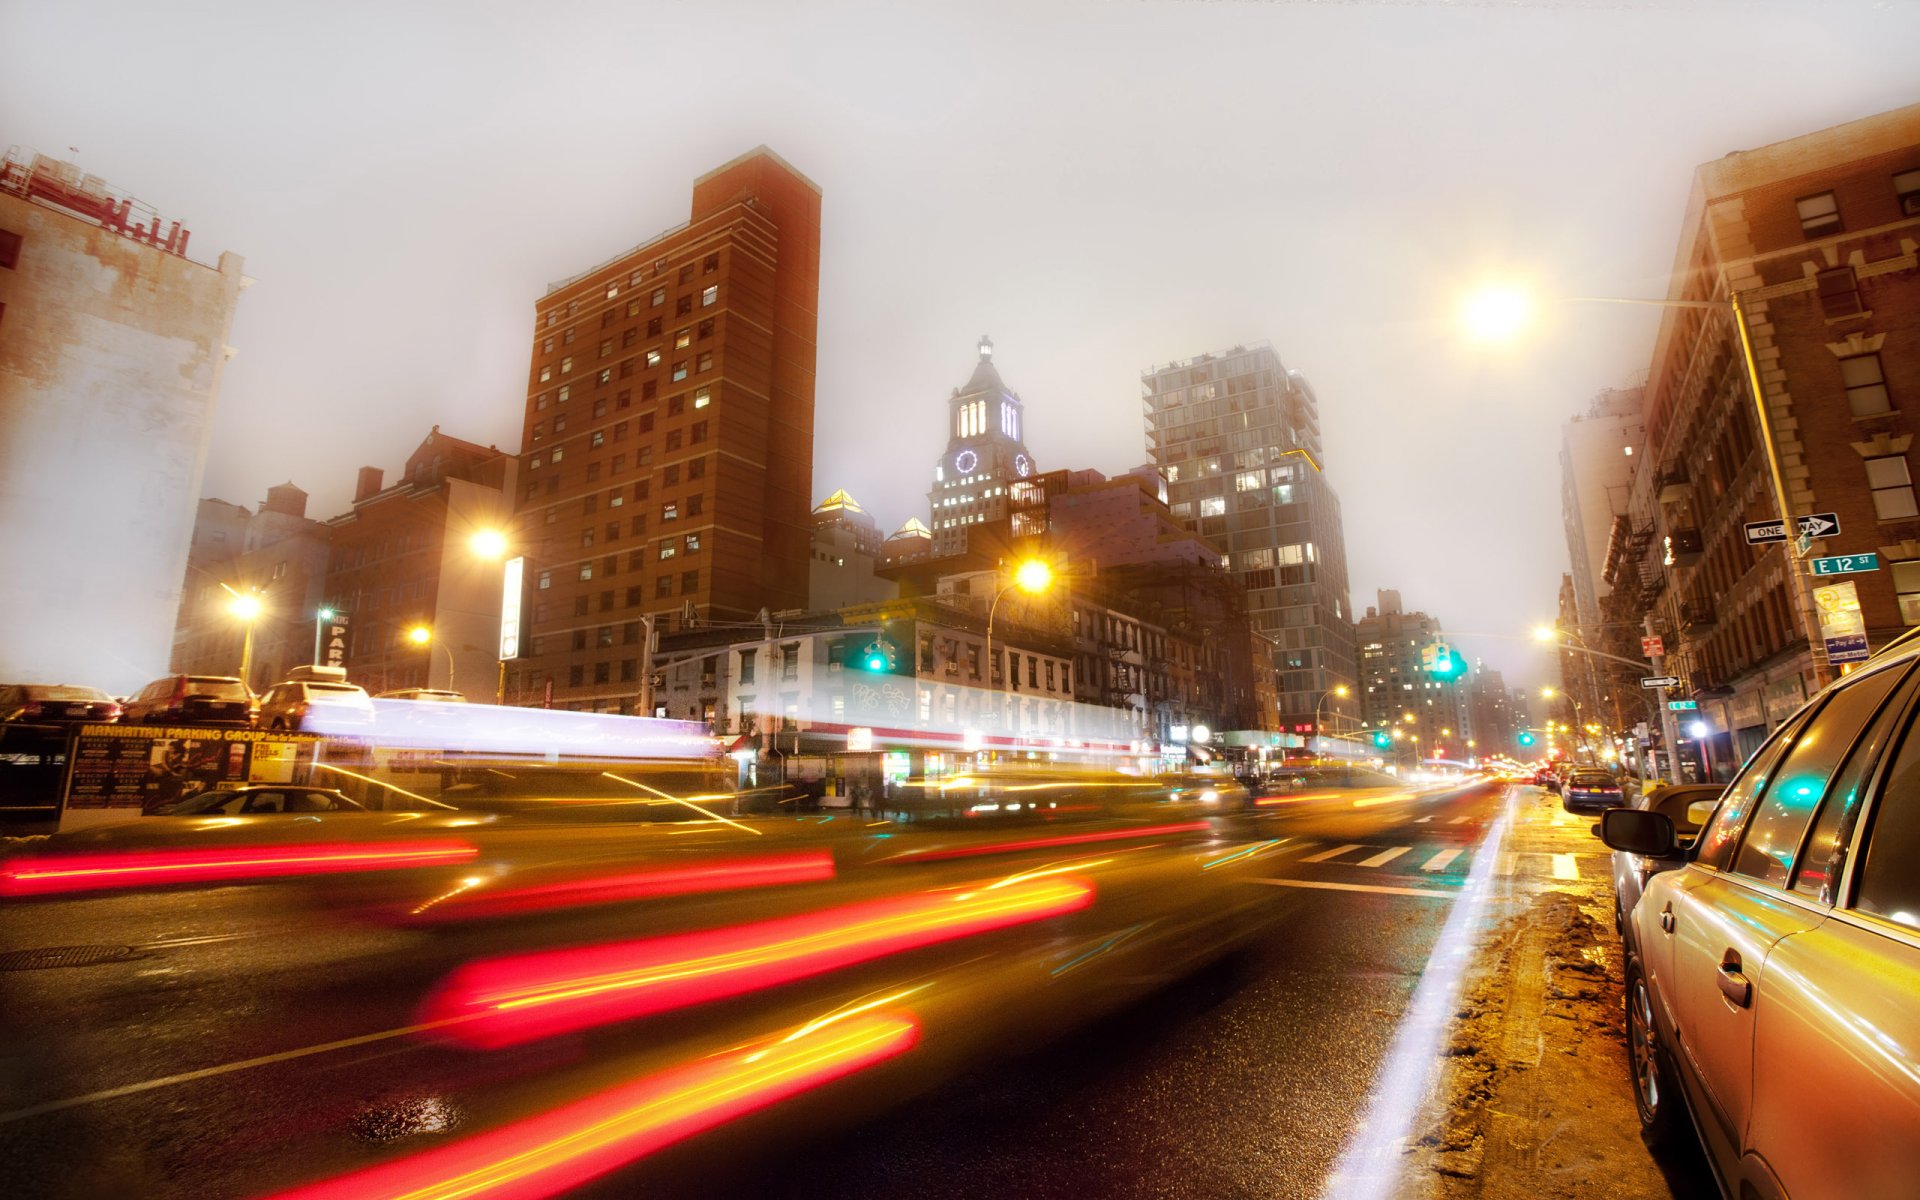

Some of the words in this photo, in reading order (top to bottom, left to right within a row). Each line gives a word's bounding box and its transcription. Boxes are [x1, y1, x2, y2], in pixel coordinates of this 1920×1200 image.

[1758, 527, 1783, 537] ONE
[1799, 521, 1823, 532] WAY
[1819, 560, 1830, 573] E
[1836, 558, 1854, 571] 12
[1859, 556, 1869, 564] ST
[1835, 640, 1848, 648] Pay
[80, 725, 164, 738] MANHATTAN
[166, 728, 222, 740] PARKING
[224, 730, 266, 742] GROUP
